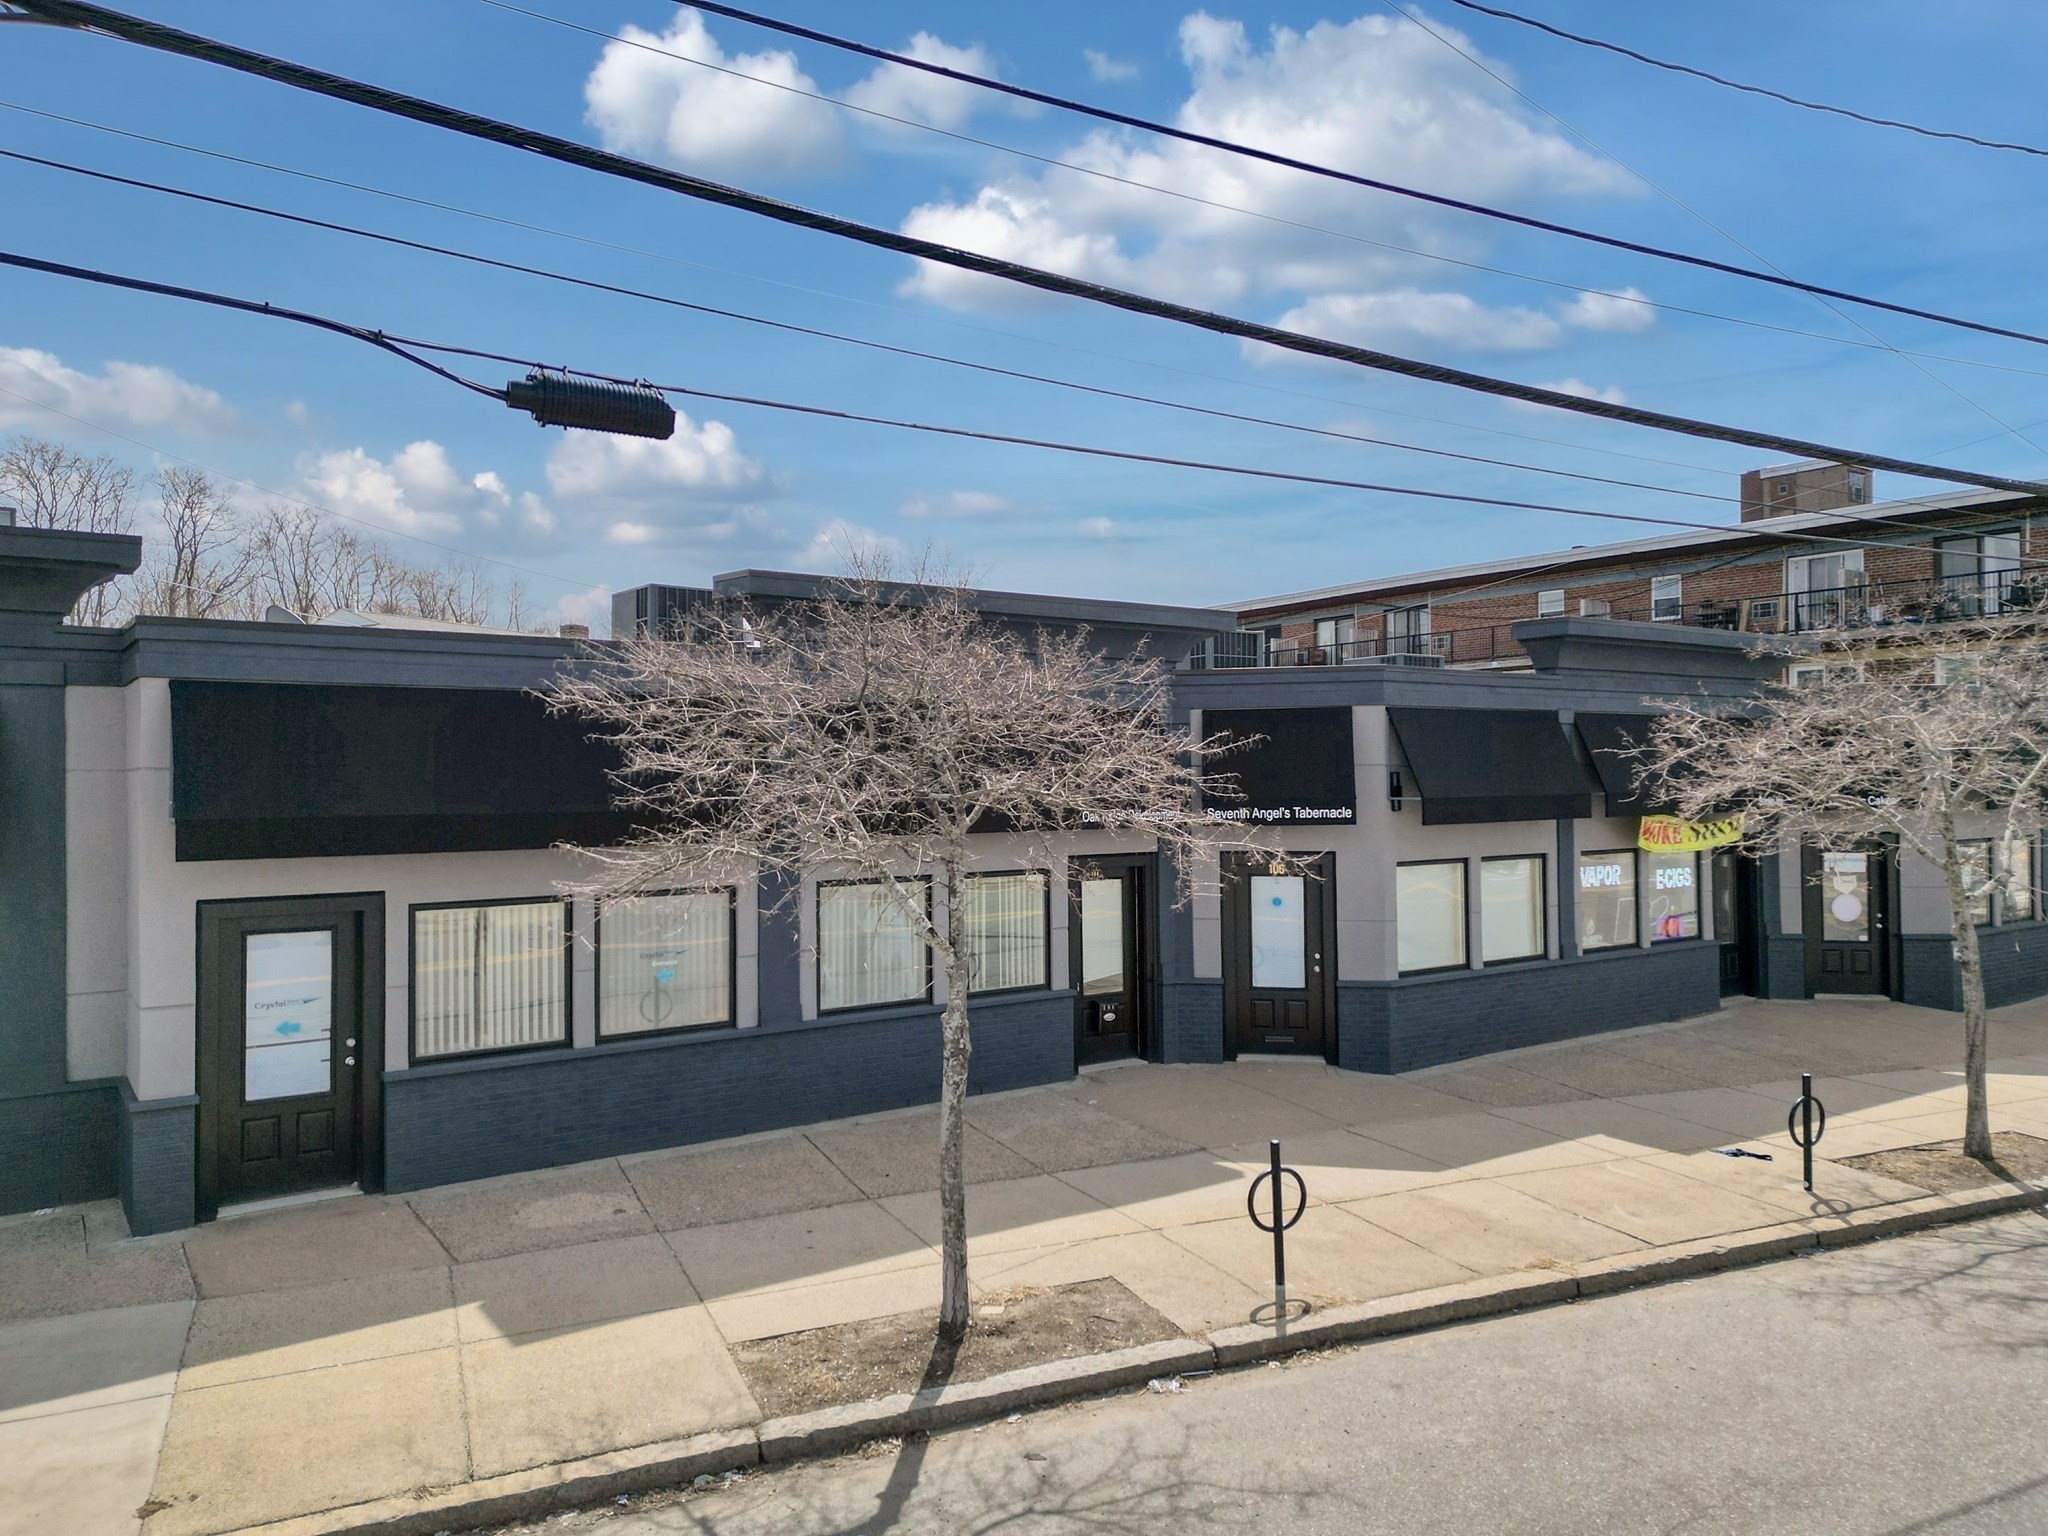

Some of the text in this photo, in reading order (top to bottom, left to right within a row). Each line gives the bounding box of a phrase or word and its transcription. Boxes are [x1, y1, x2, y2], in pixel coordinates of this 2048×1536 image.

[1207, 806, 1353, 822] Seventh Angel's Tabernacle
[1268, 863, 1286, 875] 106
[1580, 864, 1621, 888] VAPOR
[254, 1000, 286, 1010] Crystal
